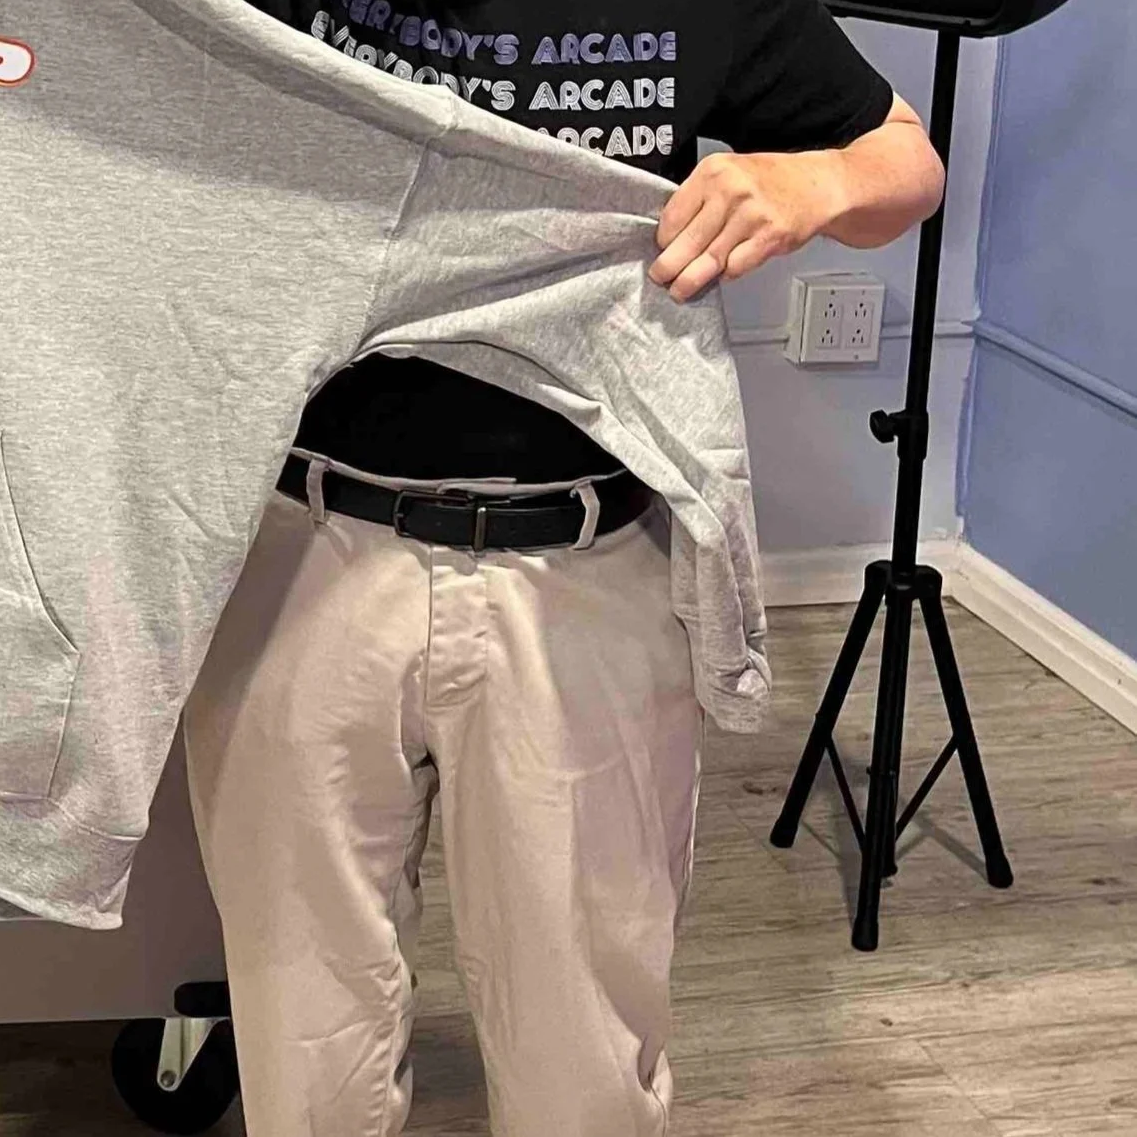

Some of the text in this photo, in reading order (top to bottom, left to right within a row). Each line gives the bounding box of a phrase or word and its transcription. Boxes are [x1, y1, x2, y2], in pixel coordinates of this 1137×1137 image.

[531, 31, 677, 65] ARCADE
[528, 77, 676, 111] ARCADE
[536, 124, 674, 157] RCADE
